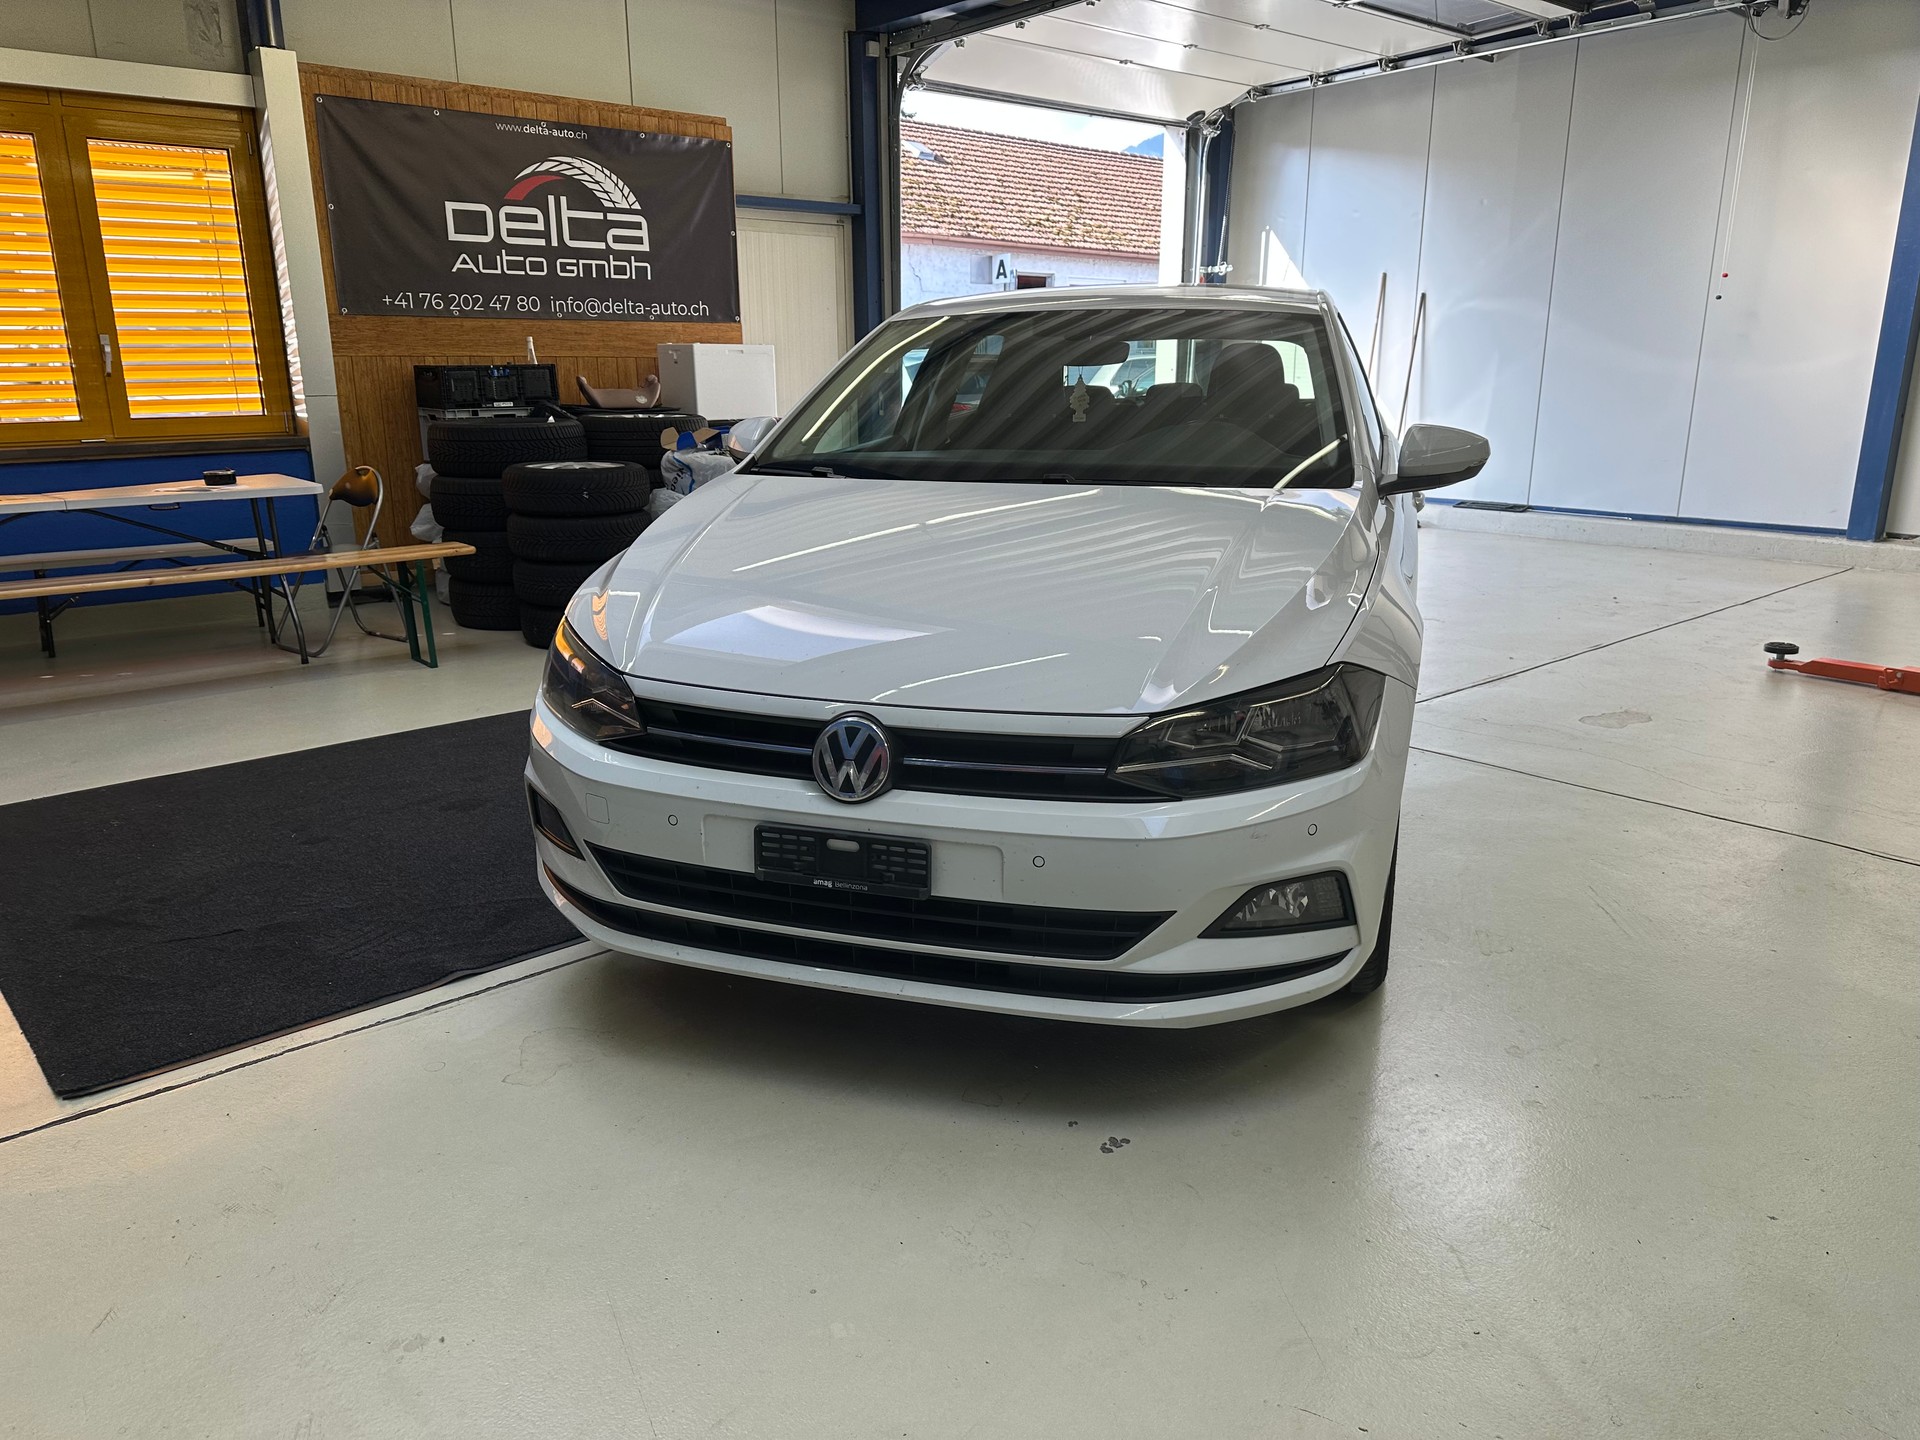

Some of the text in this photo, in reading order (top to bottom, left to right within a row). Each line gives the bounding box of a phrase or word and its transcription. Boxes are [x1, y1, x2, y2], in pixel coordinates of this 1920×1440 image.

[495, 122, 588, 140] www.delta-auto.ch
[444, 194, 650, 252] Delta
[451, 249, 548, 276] Auto
[995, 259, 1008, 280] A
[382, 292, 710, 317] +41 76 202 47 80 info@delta-auto.ch
[813, 878, 868, 891] amag Bellinzona
